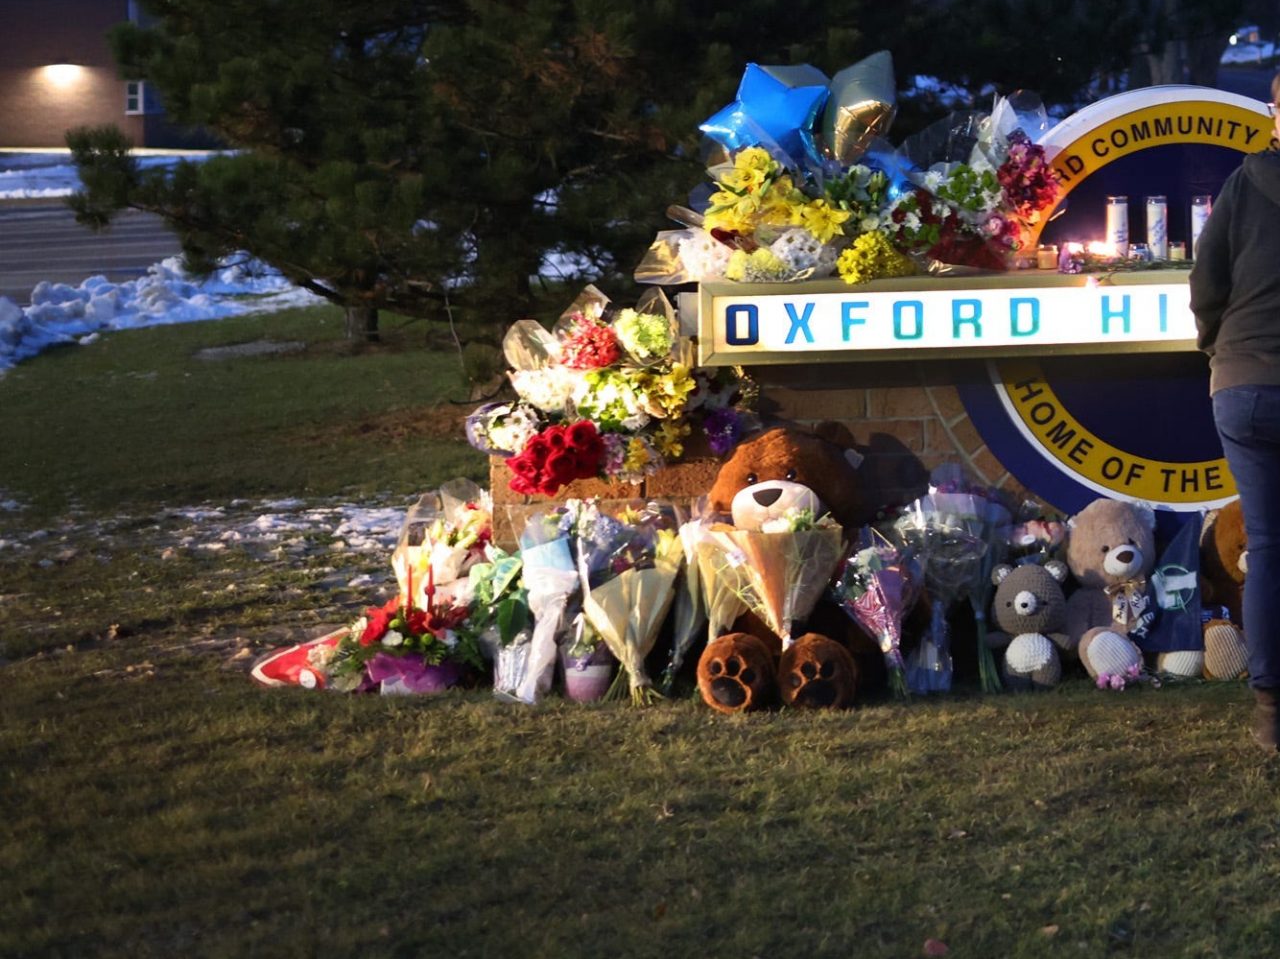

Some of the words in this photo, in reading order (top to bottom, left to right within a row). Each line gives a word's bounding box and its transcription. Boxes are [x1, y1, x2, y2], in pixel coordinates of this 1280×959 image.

[1054, 155, 1085, 184] RD
[1091, 115, 1260, 158] COMMUNITY
[725, 297, 1041, 346] OXFORD
[1101, 293, 1168, 334] HI
[1014, 377, 1094, 465] HOME
[1101, 456, 1145, 486] OF
[1160, 466, 1223, 493] THE
